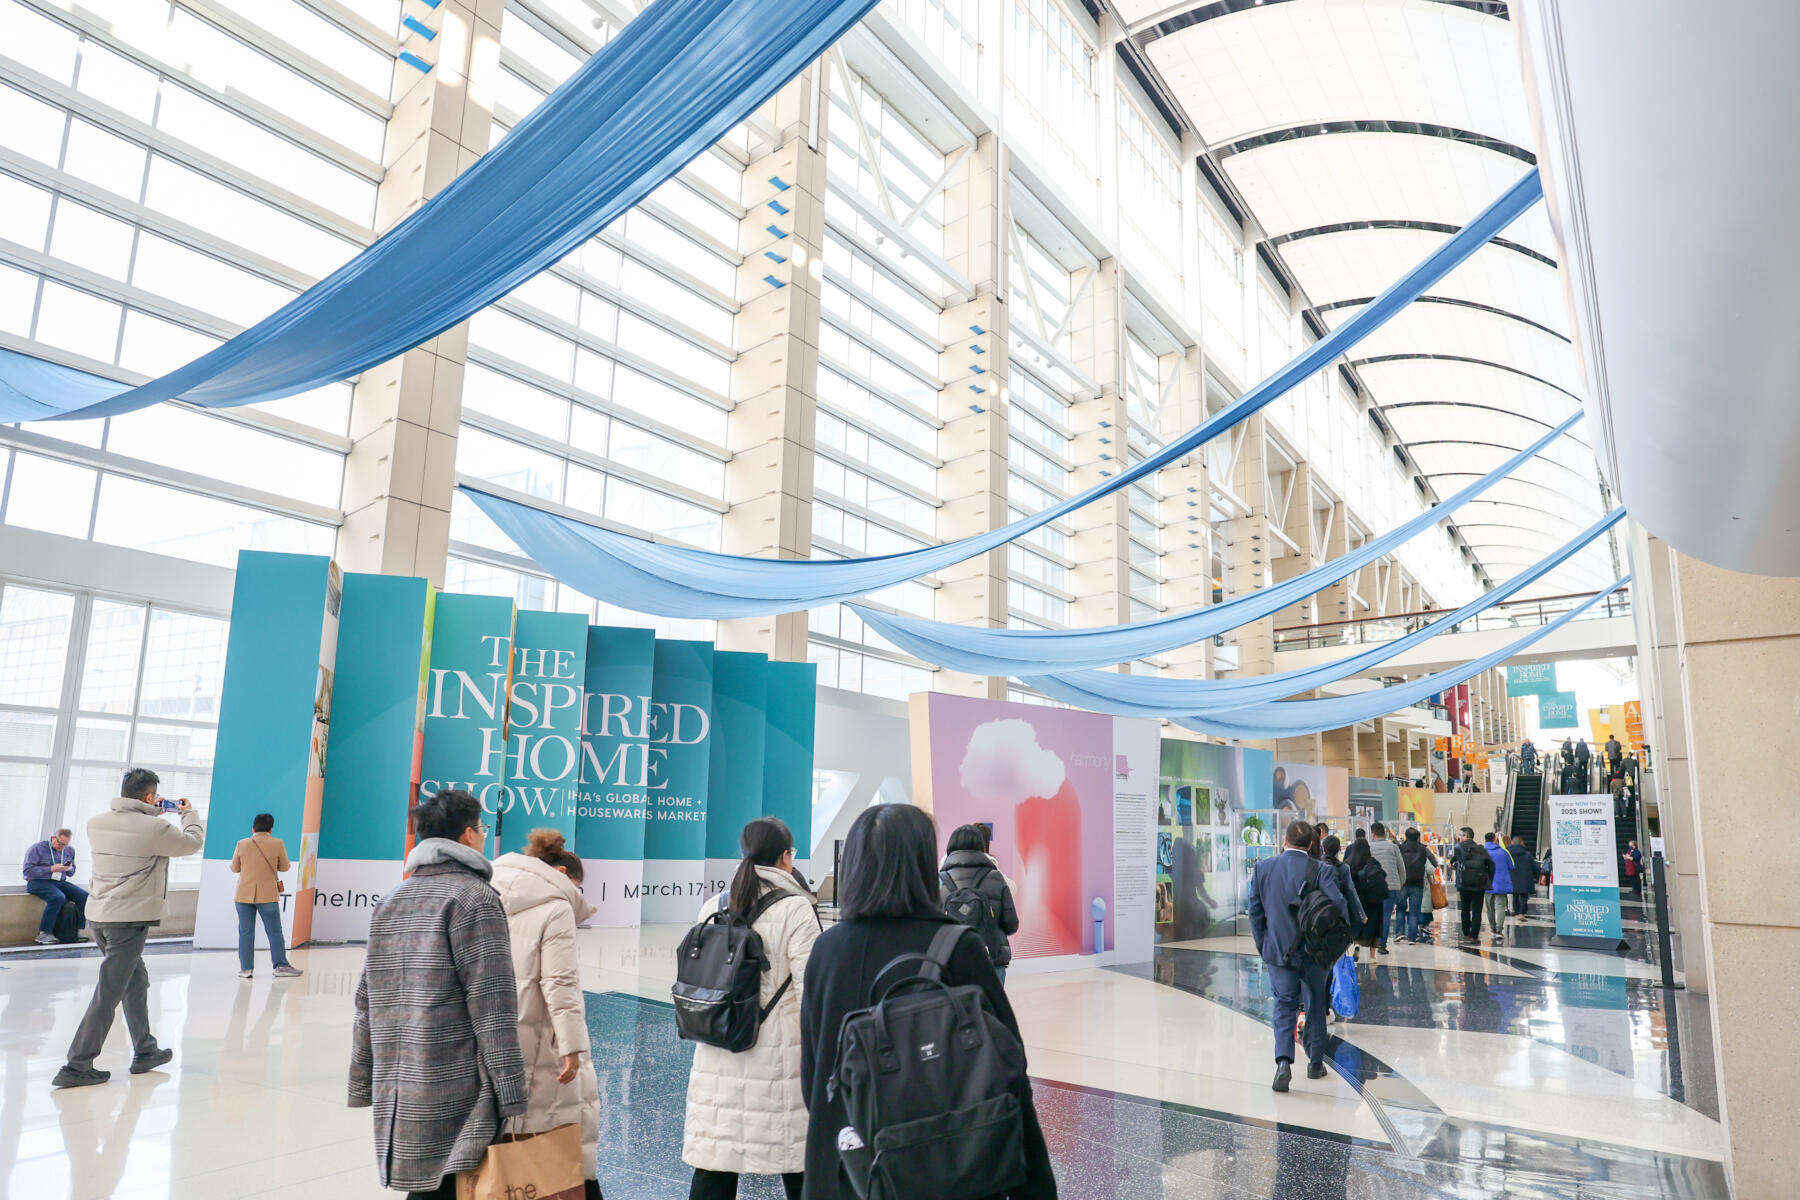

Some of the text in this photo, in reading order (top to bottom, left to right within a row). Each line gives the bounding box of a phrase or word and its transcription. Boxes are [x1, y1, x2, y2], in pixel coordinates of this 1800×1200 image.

[480, 635, 576, 679] THE
[427, 668, 710, 744] INSPIRED
[474, 727, 669, 790] HOME
[567, 789, 601, 802] IHA's
[606, 792, 653, 806] GLOBAL
[657, 796, 693, 807] HOME
[567, 805, 707, 821] HOUSEWARES MARKET
[624, 882, 682, 899] March
[1566, 903, 1610, 914] INSPIRED
[1573, 911, 1604, 922] HOME
